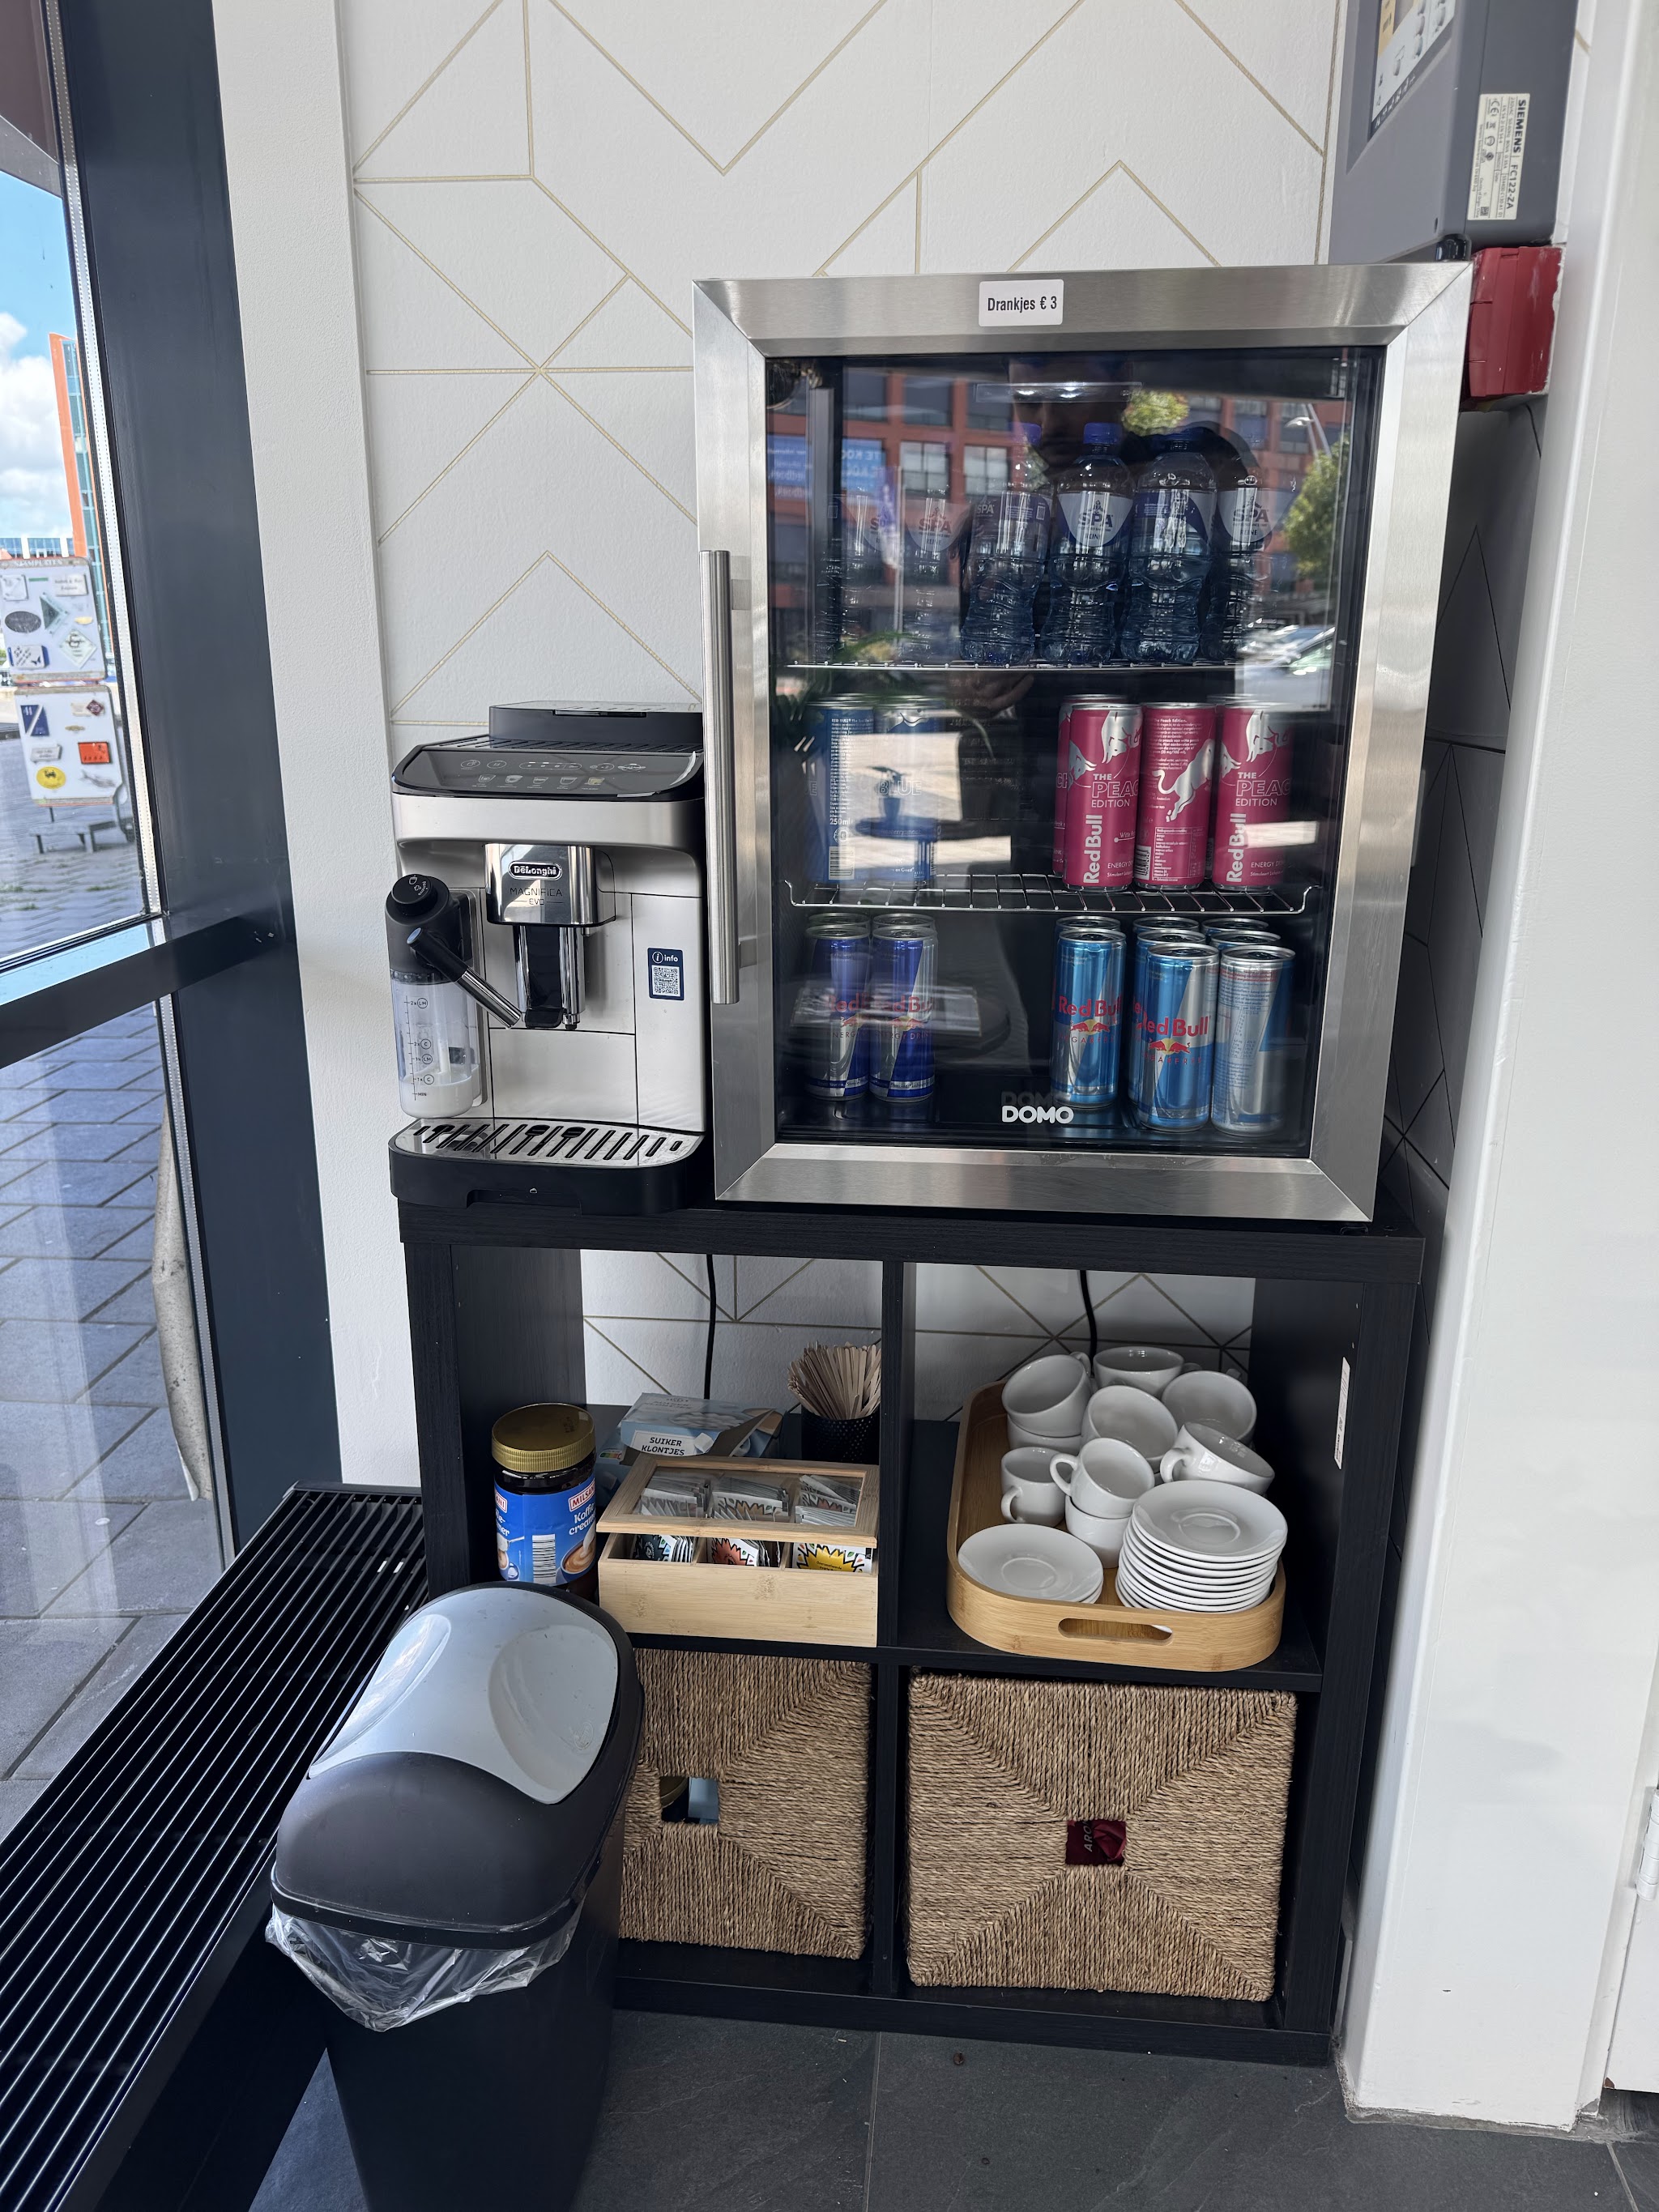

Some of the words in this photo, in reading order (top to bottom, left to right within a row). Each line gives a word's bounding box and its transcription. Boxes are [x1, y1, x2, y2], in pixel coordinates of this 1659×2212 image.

[1513, 99, 1527, 153] SIEMENS
[1506, 164, 1518, 210] FC122-ZA
[987, 297, 1036, 313] Drankjes
[1039, 296, 1047, 309] €
[1050, 296, 1057, 309] 3
[1093, 773, 1112, 781] THE
[1237, 771, 1257, 779] THE
[879, 780, 922, 795] BLUE
[1091, 799, 1130, 808] EDITION
[1235, 798, 1277, 807] EDITION
[830, 817, 842, 825] 250
[1085, 814, 1102, 848] Bull
[1228, 812, 1247, 846] Bull
[1083, 849, 1101, 884] Red
[1107, 861, 1128, 869] ENERGY
[1226, 848, 1244, 883] Red
[510, 887, 563, 897] MAGNIFICA
[529, 897, 545, 906] EVO
[664, 954, 679, 962] info
[1059, 995, 1092, 1016] Red
[1172, 1016, 1209, 1037] Bull
[1001, 1105, 1074, 1124] DOMO
[649, 1437, 682, 1447] SUIKER
[641, 1445, 685, 1456] KLONTJES
[1083, 1819, 1093, 1852] ARO
